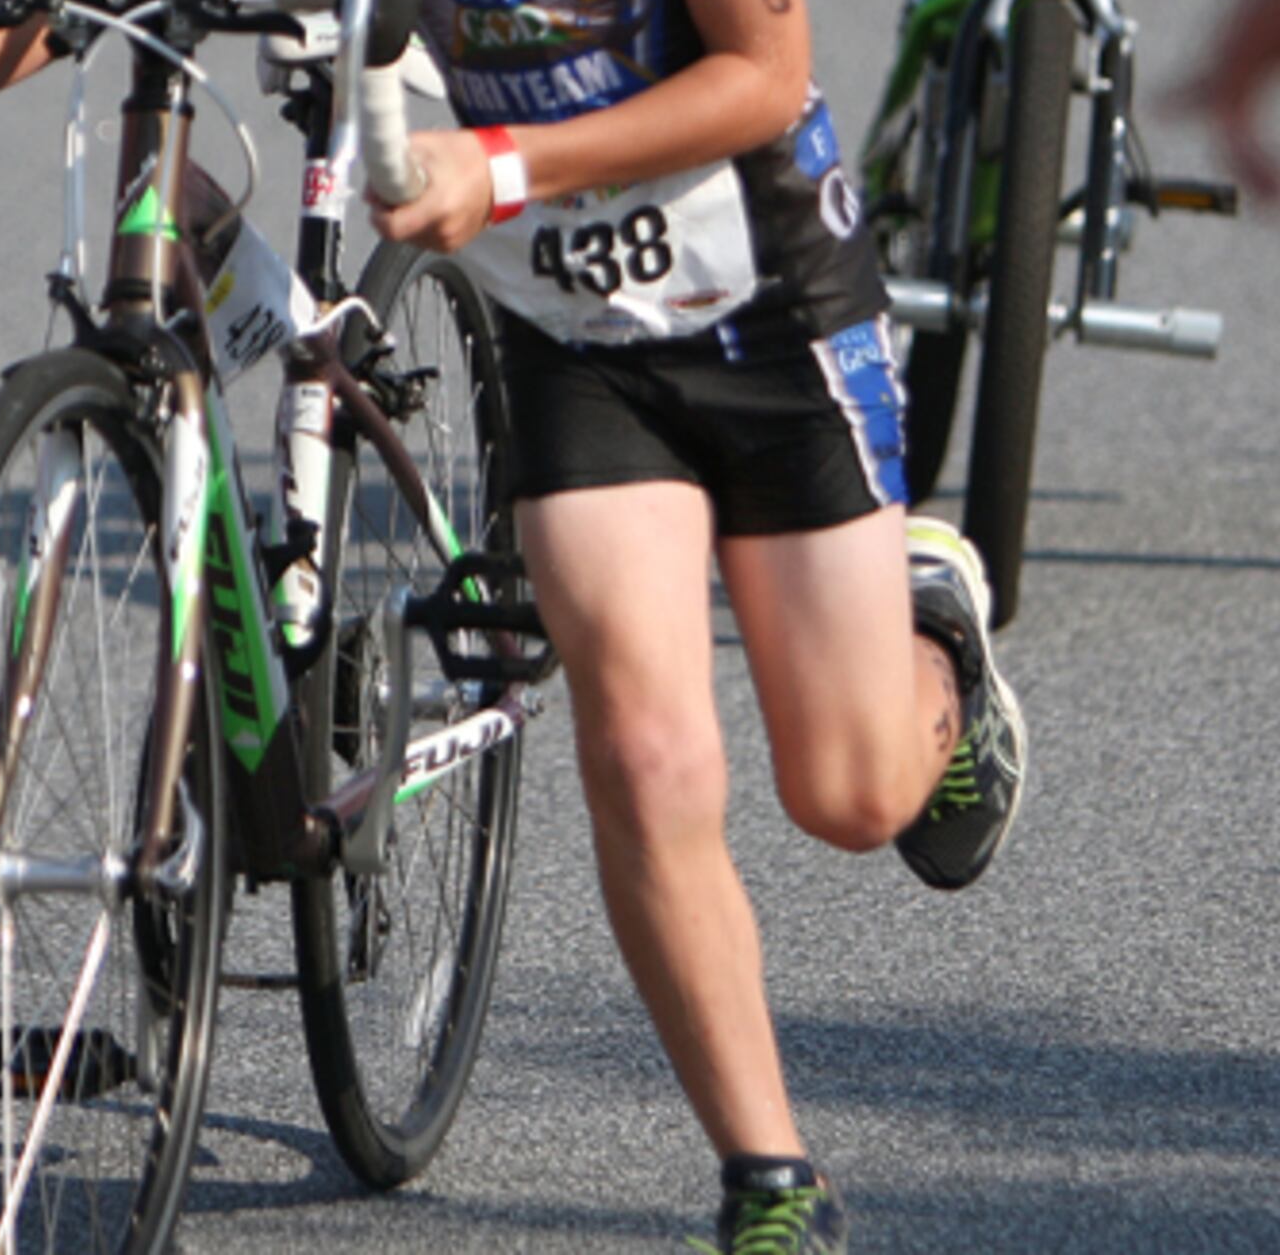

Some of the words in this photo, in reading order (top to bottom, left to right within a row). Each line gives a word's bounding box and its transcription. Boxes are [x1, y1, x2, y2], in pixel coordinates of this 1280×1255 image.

[500, 49, 621, 113] TEAM
[531, 204, 673, 298] 438
[400, 717, 504, 786] FUJI
